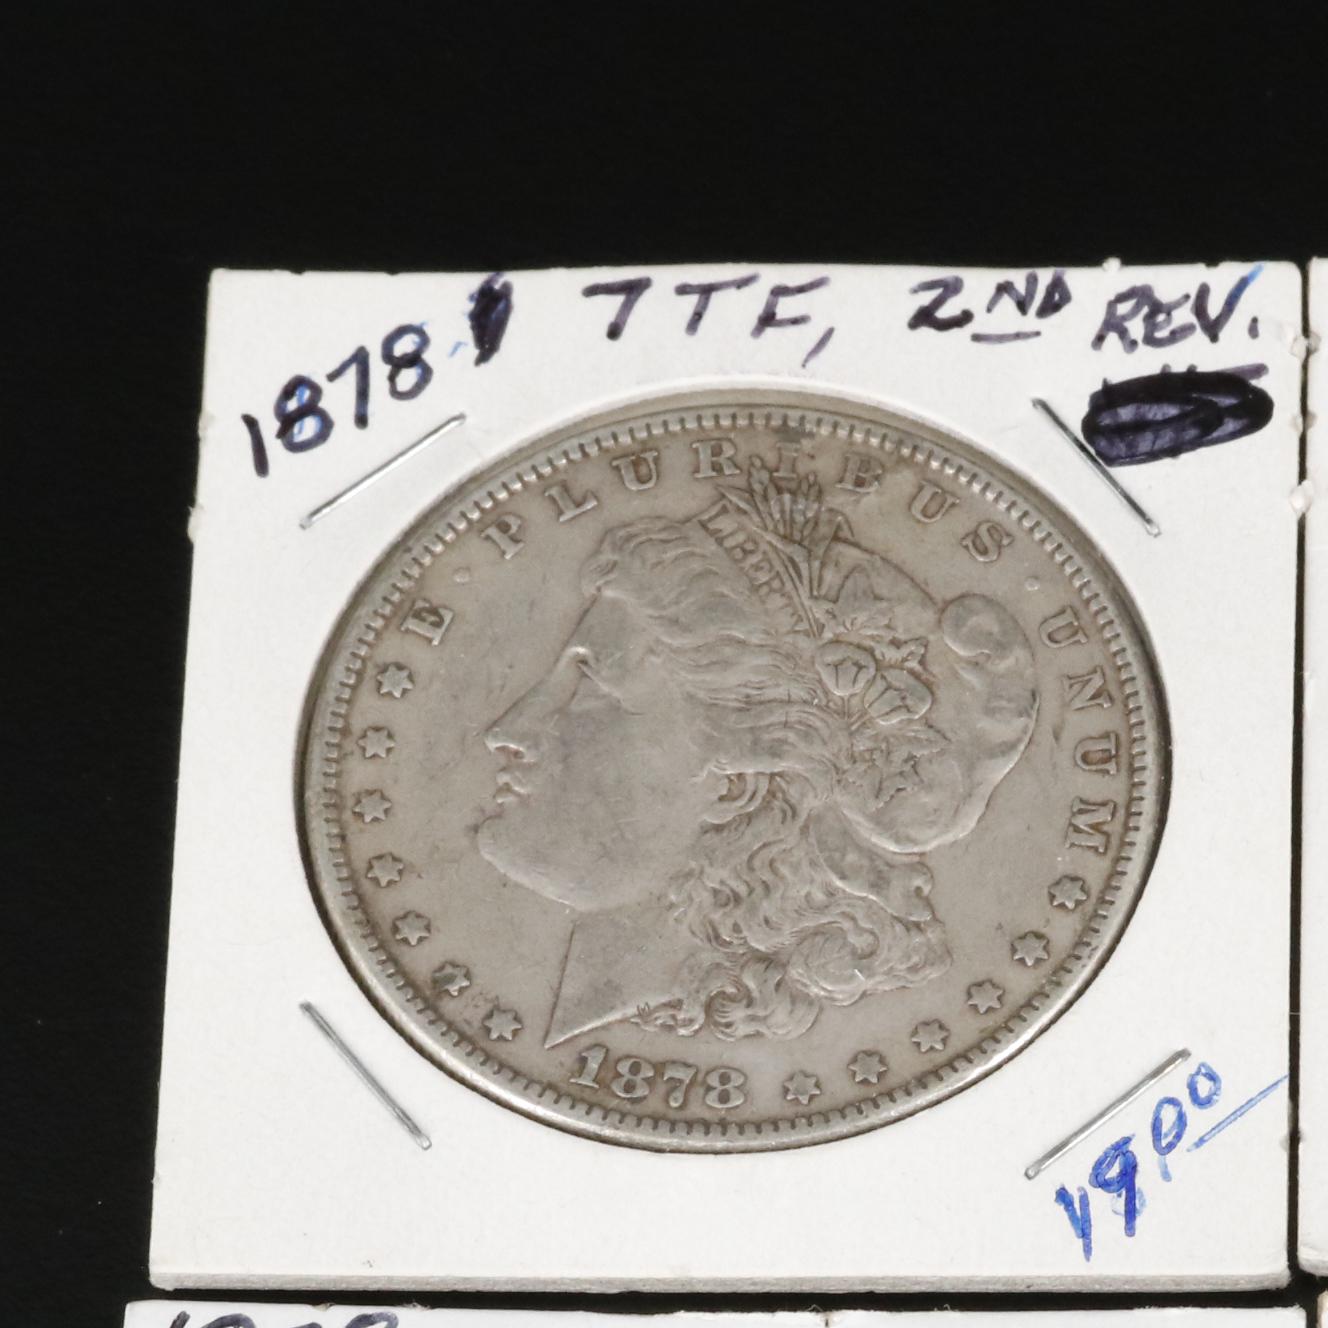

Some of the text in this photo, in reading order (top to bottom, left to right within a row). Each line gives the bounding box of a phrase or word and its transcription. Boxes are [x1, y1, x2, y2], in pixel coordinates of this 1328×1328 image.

[908, 269, 1073, 343] 2ND
[1092, 264, 1265, 353] REV.
[242, 322, 434, 478] 1878
[402, 437, 1122, 855] E PLURIBUS UNUM
[568, 1043, 748, 1112] 1878
